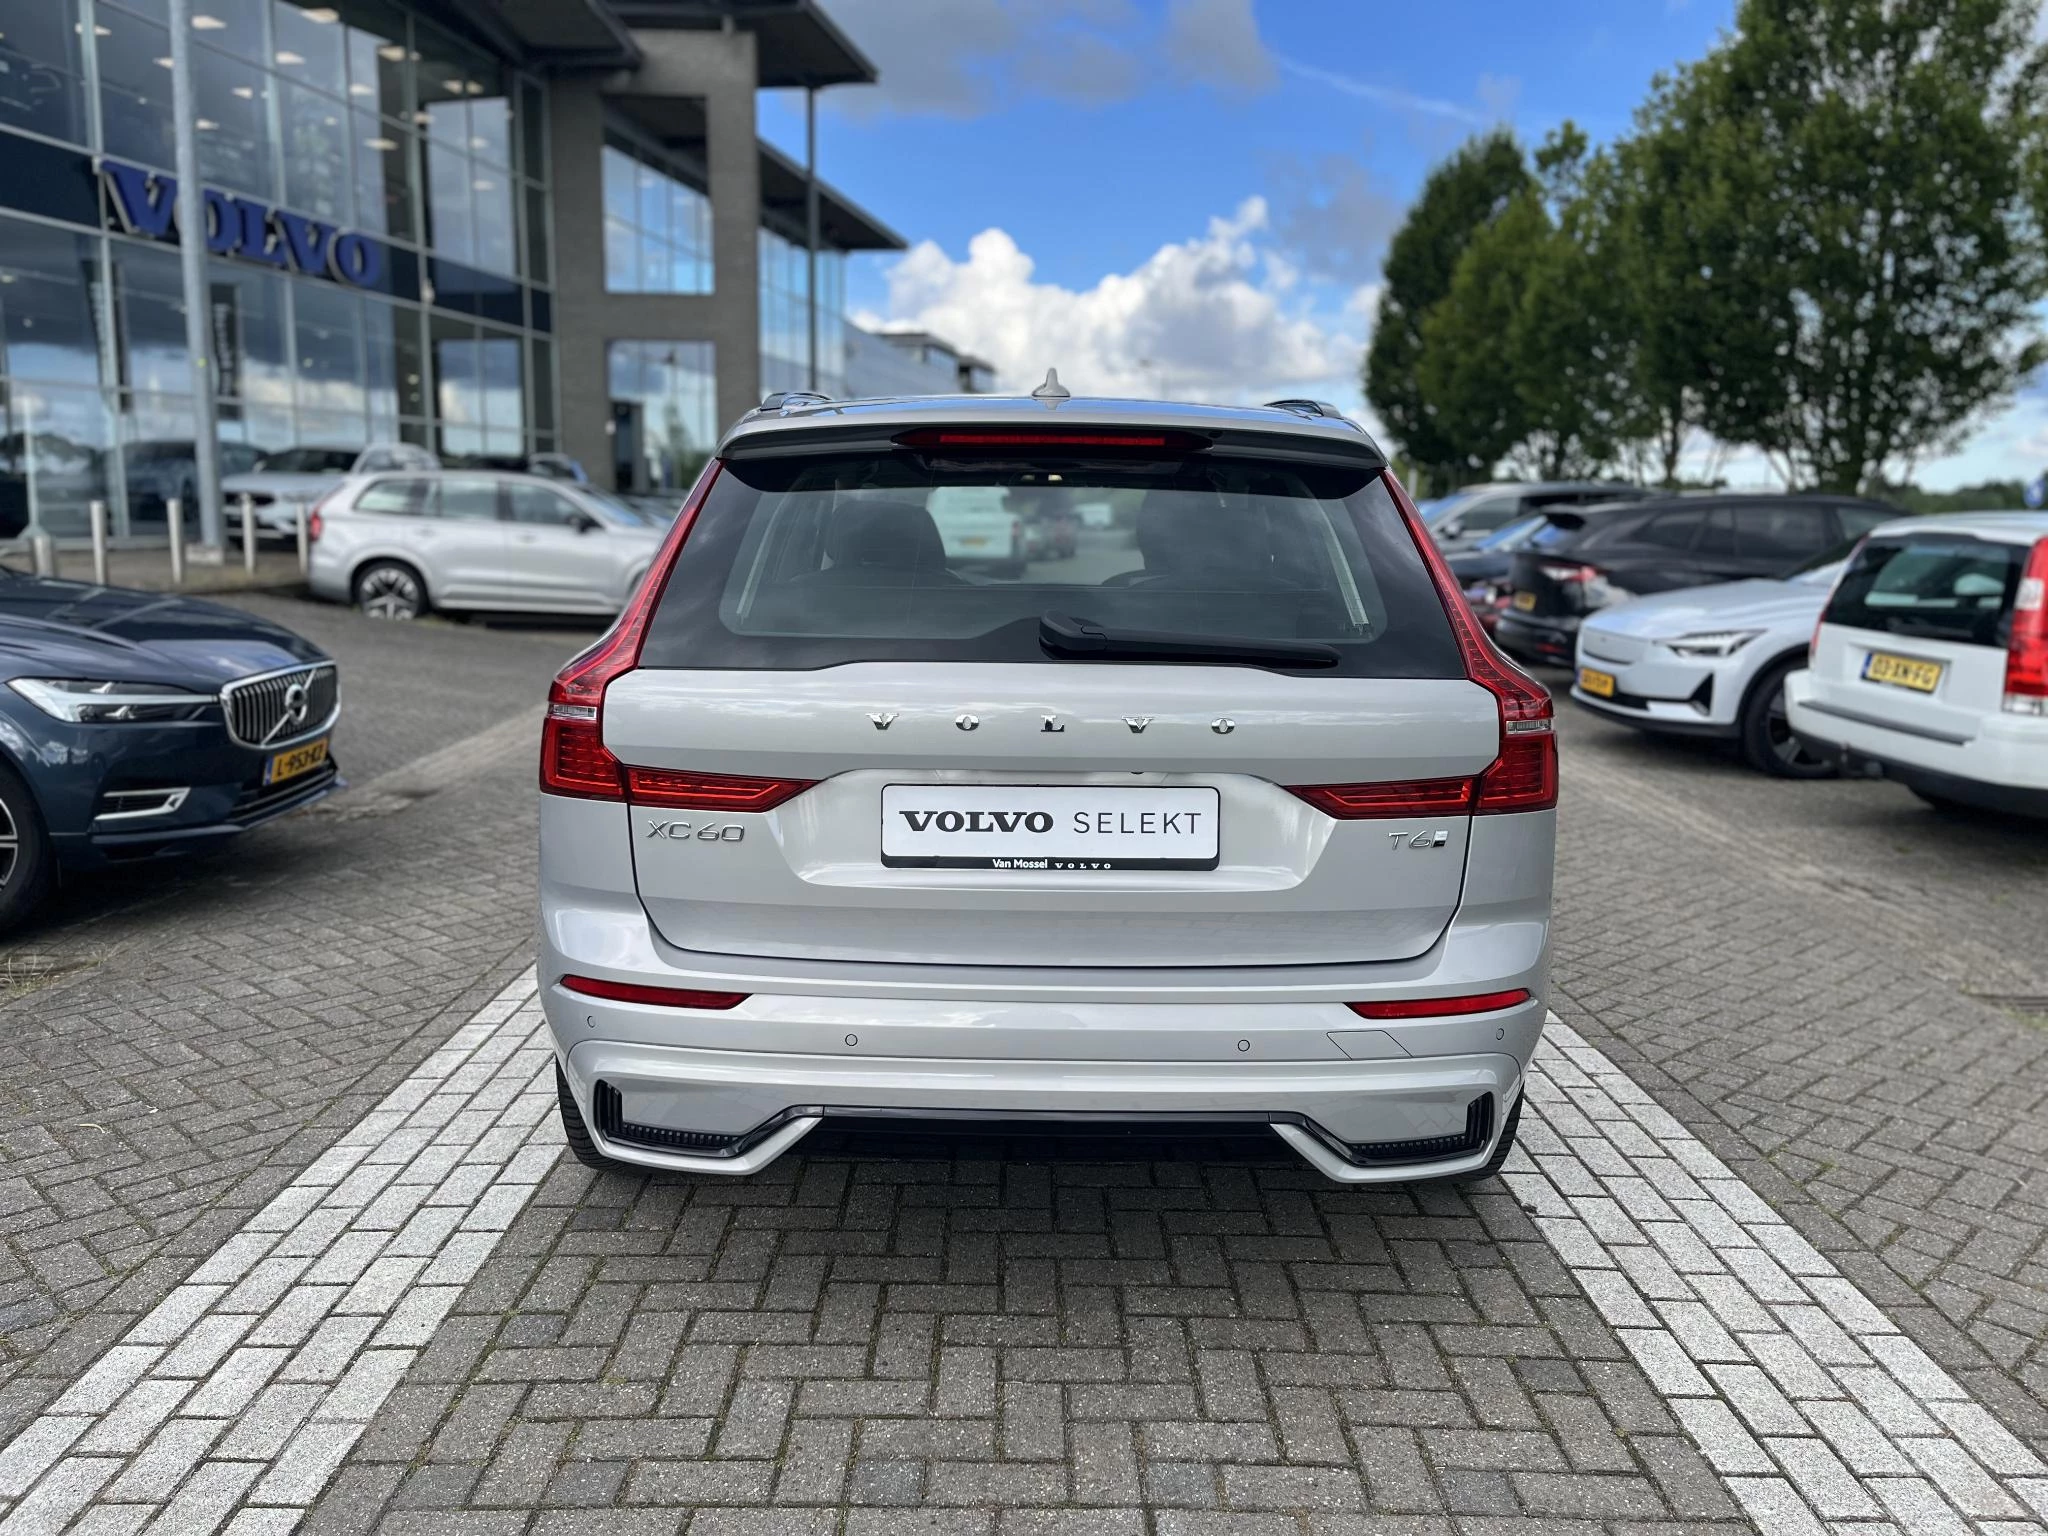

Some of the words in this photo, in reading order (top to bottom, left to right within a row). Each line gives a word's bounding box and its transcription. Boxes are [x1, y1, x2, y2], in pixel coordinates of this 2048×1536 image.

[100, 159, 381, 287] VOLVO
[866, 712, 1236, 735] VOLVO
[899, 810, 1054, 833] VOLVO
[1073, 812, 1202, 834] SELEKT
[992, 858, 1012, 869] Van
[1013, 858, 1048, 869] Mossel
